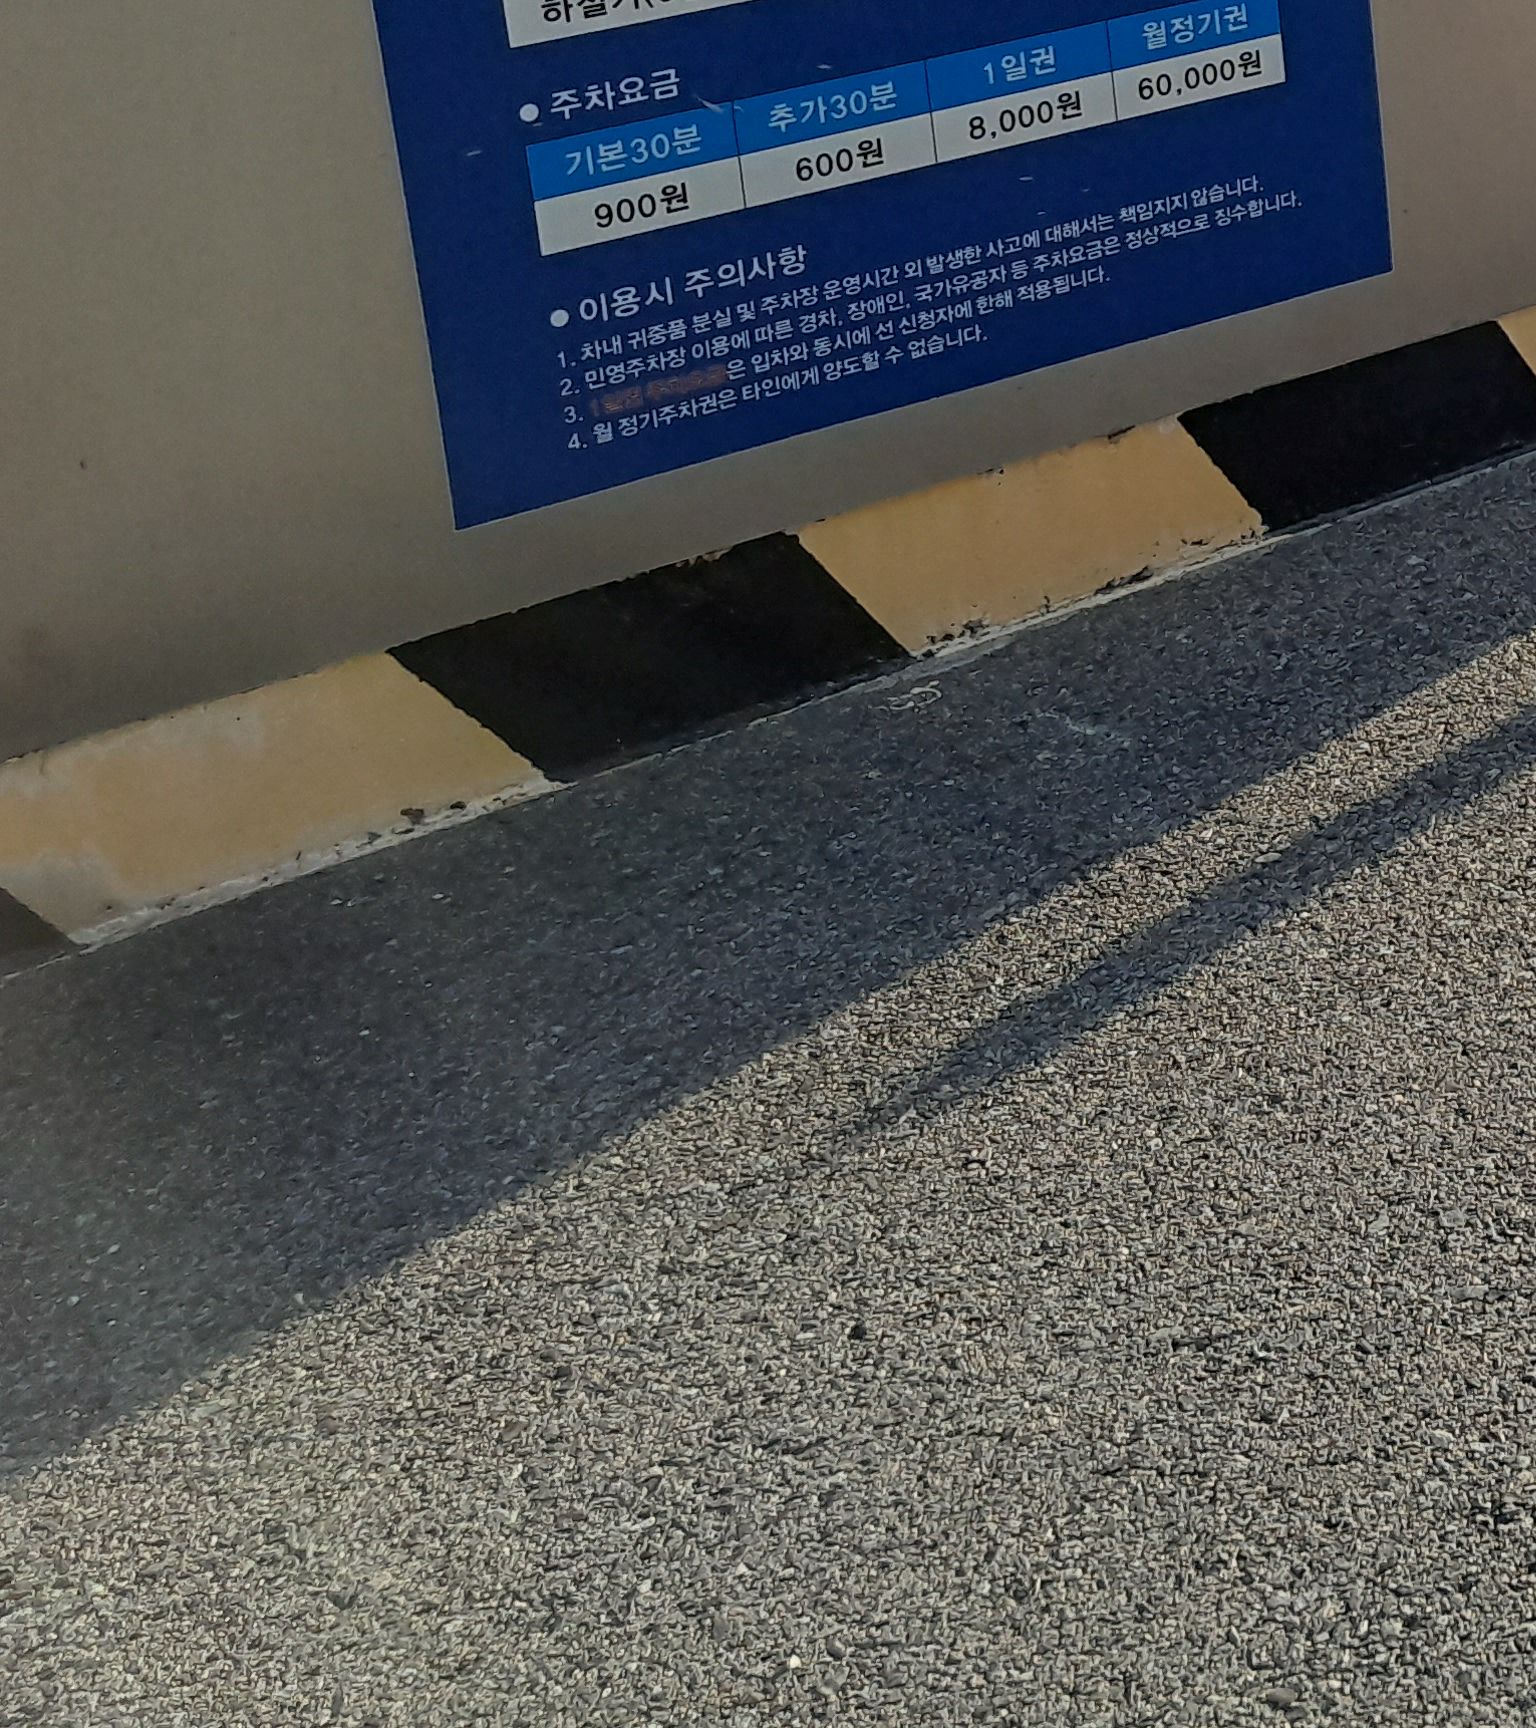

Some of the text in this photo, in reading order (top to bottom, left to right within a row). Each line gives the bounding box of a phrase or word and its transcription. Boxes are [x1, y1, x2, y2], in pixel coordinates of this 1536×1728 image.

[550, 68, 680, 120] 주차요금
[565, 2, 1248, 175] 기본30분 추가30분 1일권 월정기권
[594, 49, 1262, 228] 900원 600원 8,000원 60,000원
[579, 244, 807, 321] 이용시 주의사항
[580, 334, 623, 360] 차내
[627, 318, 688, 350] 귀중품
[691, 306, 732, 334] 분실
[736, 300, 756, 322] 및
[760, 284, 819, 315] 주차장
[822, 264, 899, 301] 운영시간
[904, 258, 923, 278] 외
[925, 244, 982, 275] 발생한
[985, 229, 1040, 257] 사고에
[1044, 213, 1115, 242] 대해서는
[1118, 191, 1188, 223] 책임지지
[1190, 174, 1264, 207] 않습니다.
[584, 345, 687, 390] 민영주차장
[691, 329, 751, 359] 이용에
[754, 318, 794, 343] 따른
[798, 306, 843, 333] 경차,
[913, 264, 1007, 302] 국가유공자
[1010, 259, 1029, 280] 등
[1032, 235, 1121, 273] 주차요금은
[1125, 213, 1211, 250] 정상적으로
[1214, 189, 1302, 226] 징수합니다.
[750, 341, 809, 374] 입차와
[812, 324, 871, 357] 동시에
[874, 319, 894, 341] 선
[898, 299, 973, 335] 신청자에
[975, 288, 1013, 315] 한해
[1016, 264, 1110, 302] 적용됩니다.
[741, 364, 820, 400] 타인에게
[822, 349, 880, 381] 양도할
[884, 345, 904, 364] 수
[907, 323, 988, 359] 없습니다.
